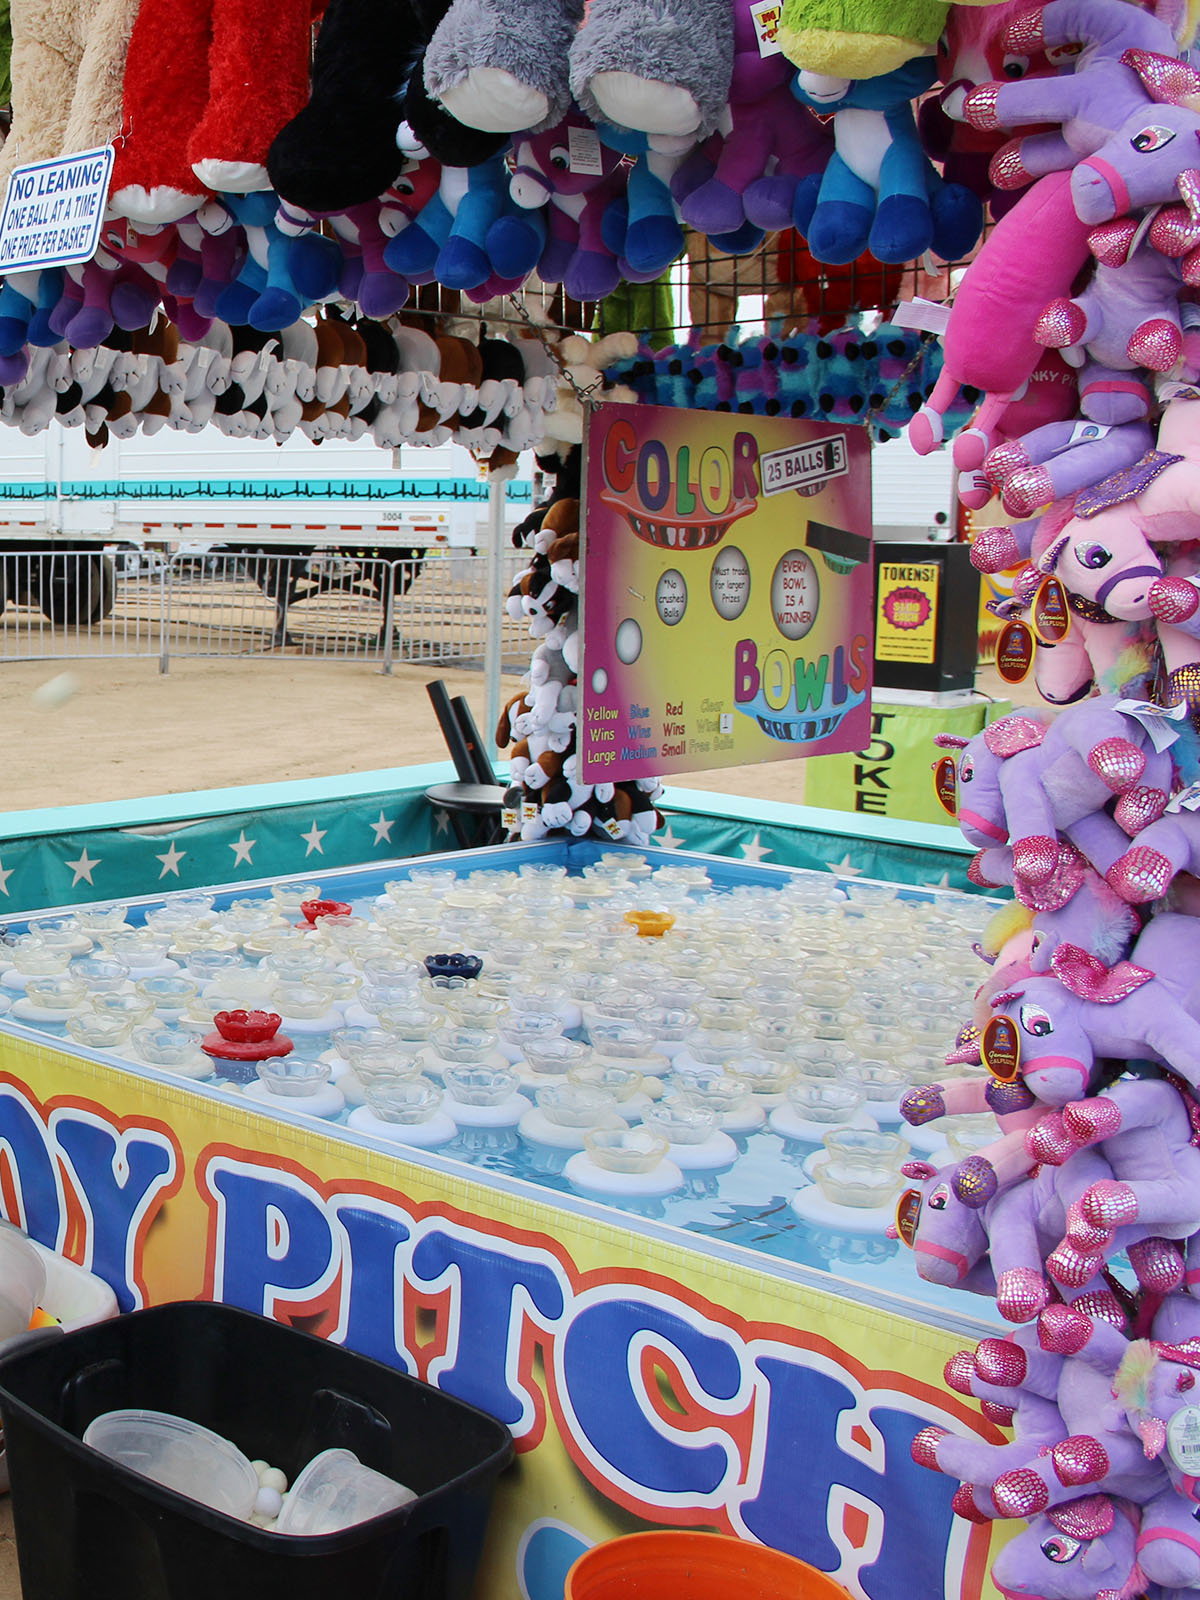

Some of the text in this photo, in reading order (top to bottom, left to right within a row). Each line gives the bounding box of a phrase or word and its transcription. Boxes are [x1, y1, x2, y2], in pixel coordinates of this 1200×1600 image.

[13, 161, 103, 201] NO LEANING
[7, 192, 98, 230] ONE BALL AT A TIME
[0, 224, 91, 261] ONE PRIZE PER BASKET
[604, 419, 760, 516] COLOR
[767, 462, 782, 482] 25
[785, 450, 824, 478] BALLS
[782, 560, 807, 573] EVERY
[882, 566, 935, 582] TOKENS!
[726, 580, 746, 592] larger
[783, 578, 807, 590] BOWL
[658, 593, 685, 604] crushed
[785, 595, 804, 607] IS A
[663, 607, 679, 618] Balls
[777, 611, 812, 624] WINNER
[734, 634, 868, 712] BOWLS
[587, 706, 618, 721] Yellow
[630, 704, 650, 720] Blue
[666, 701, 683, 716] Red
[590, 728, 615, 742] Wins
[628, 725, 651, 739] Wins
[663, 722, 685, 736] Wins
[621, 745, 657, 760] Medium
[661, 741, 686, 757] Small
[587, 750, 616, 766] Large
[202, 1155, 992, 1600] PITCH
